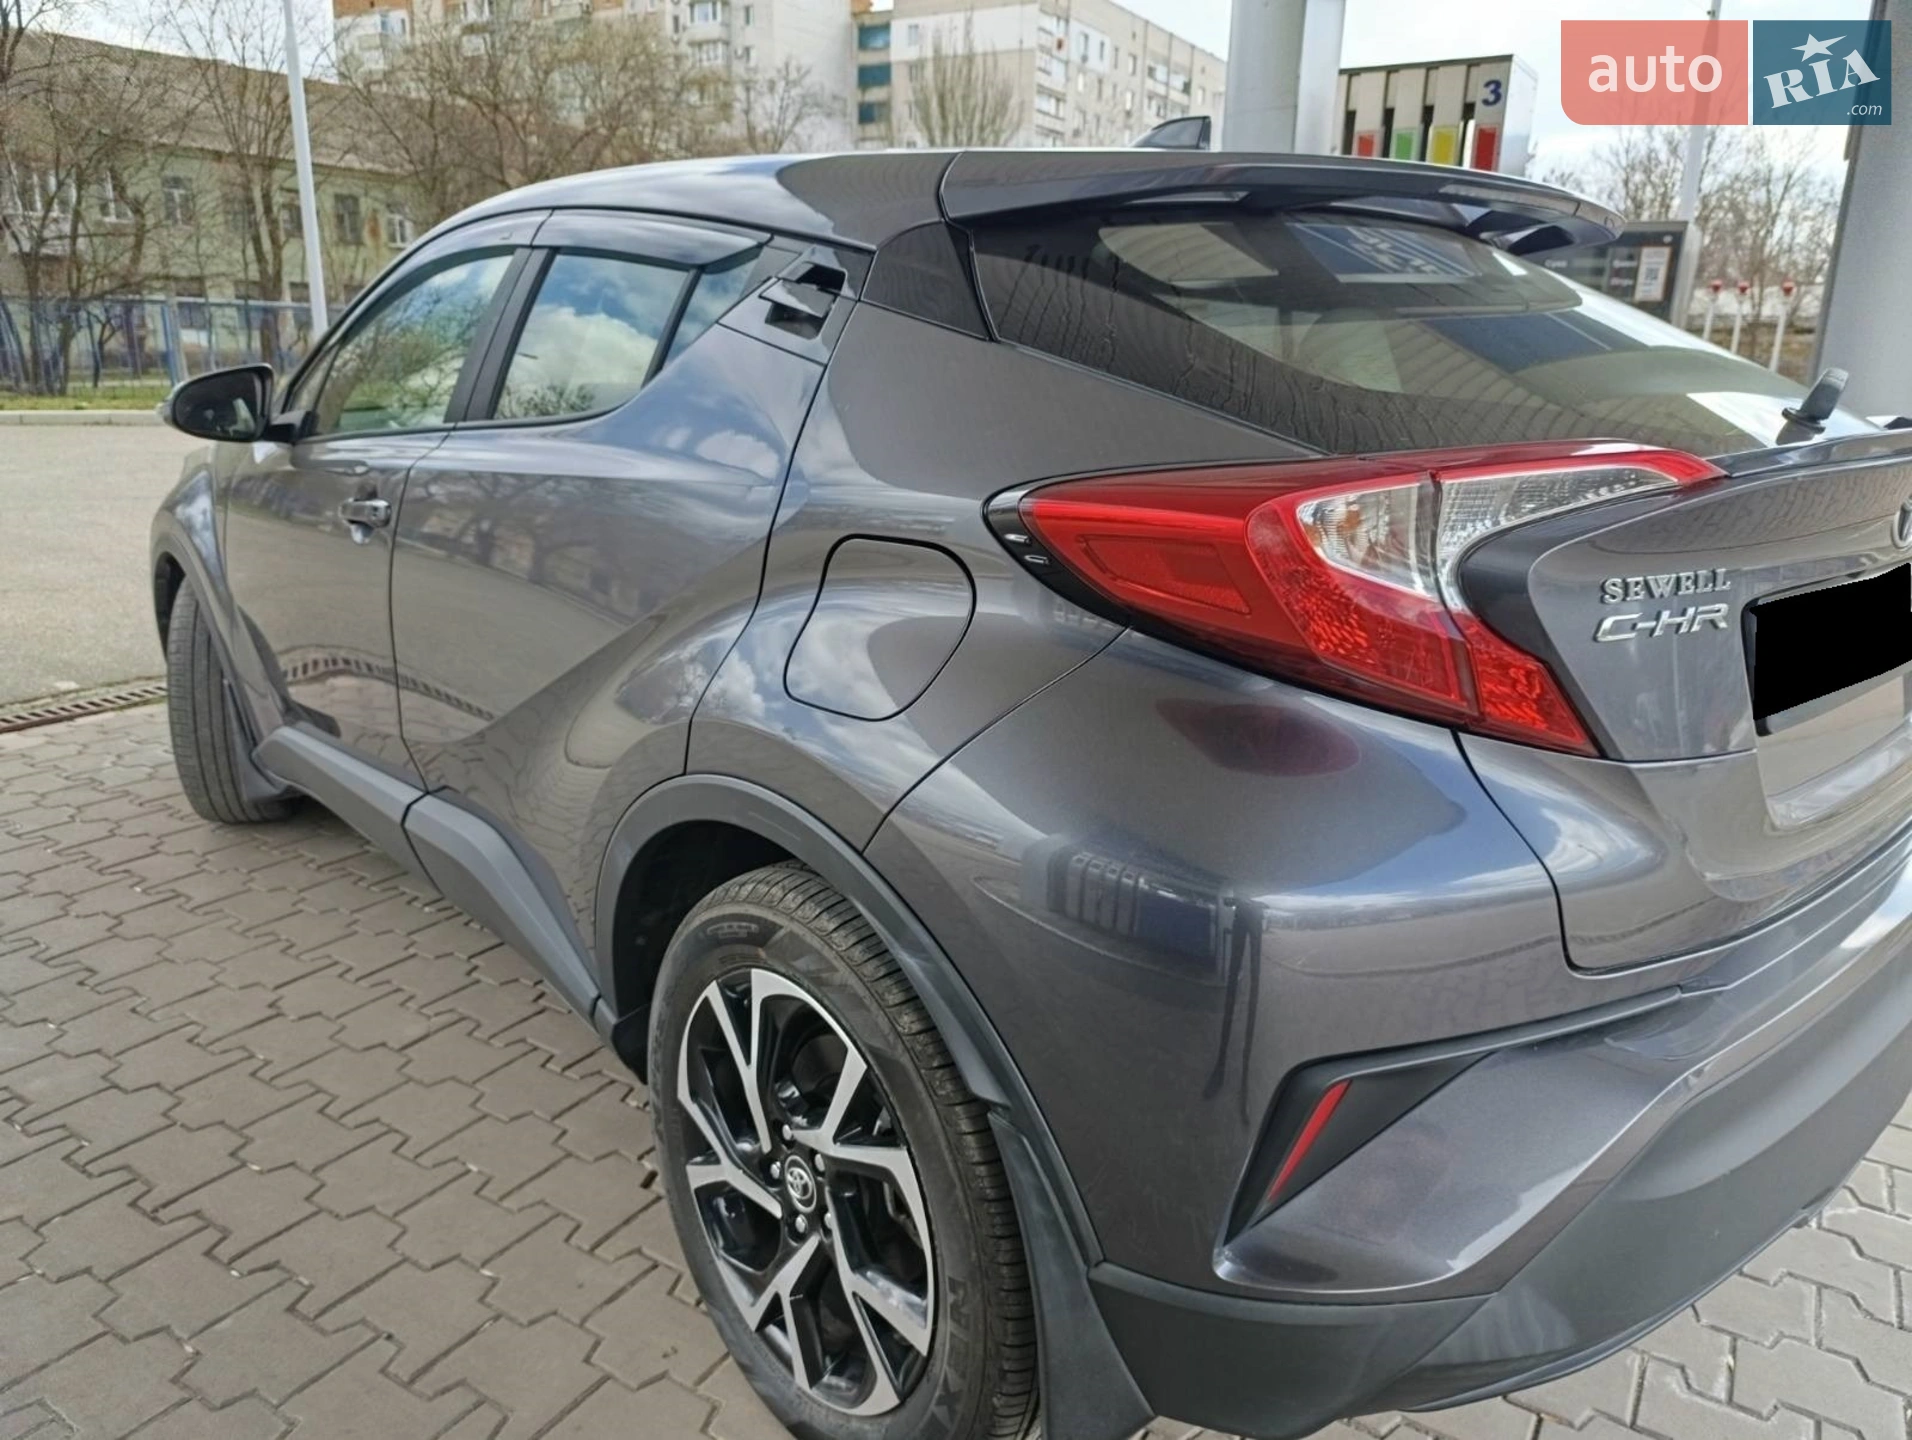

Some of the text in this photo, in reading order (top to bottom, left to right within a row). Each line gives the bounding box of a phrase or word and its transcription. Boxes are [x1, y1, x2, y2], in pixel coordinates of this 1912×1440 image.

[1481, 79, 1503, 107] 3
[1601, 568, 1731, 604] SEWELL
[1594, 603, 1729, 642] C-HR
